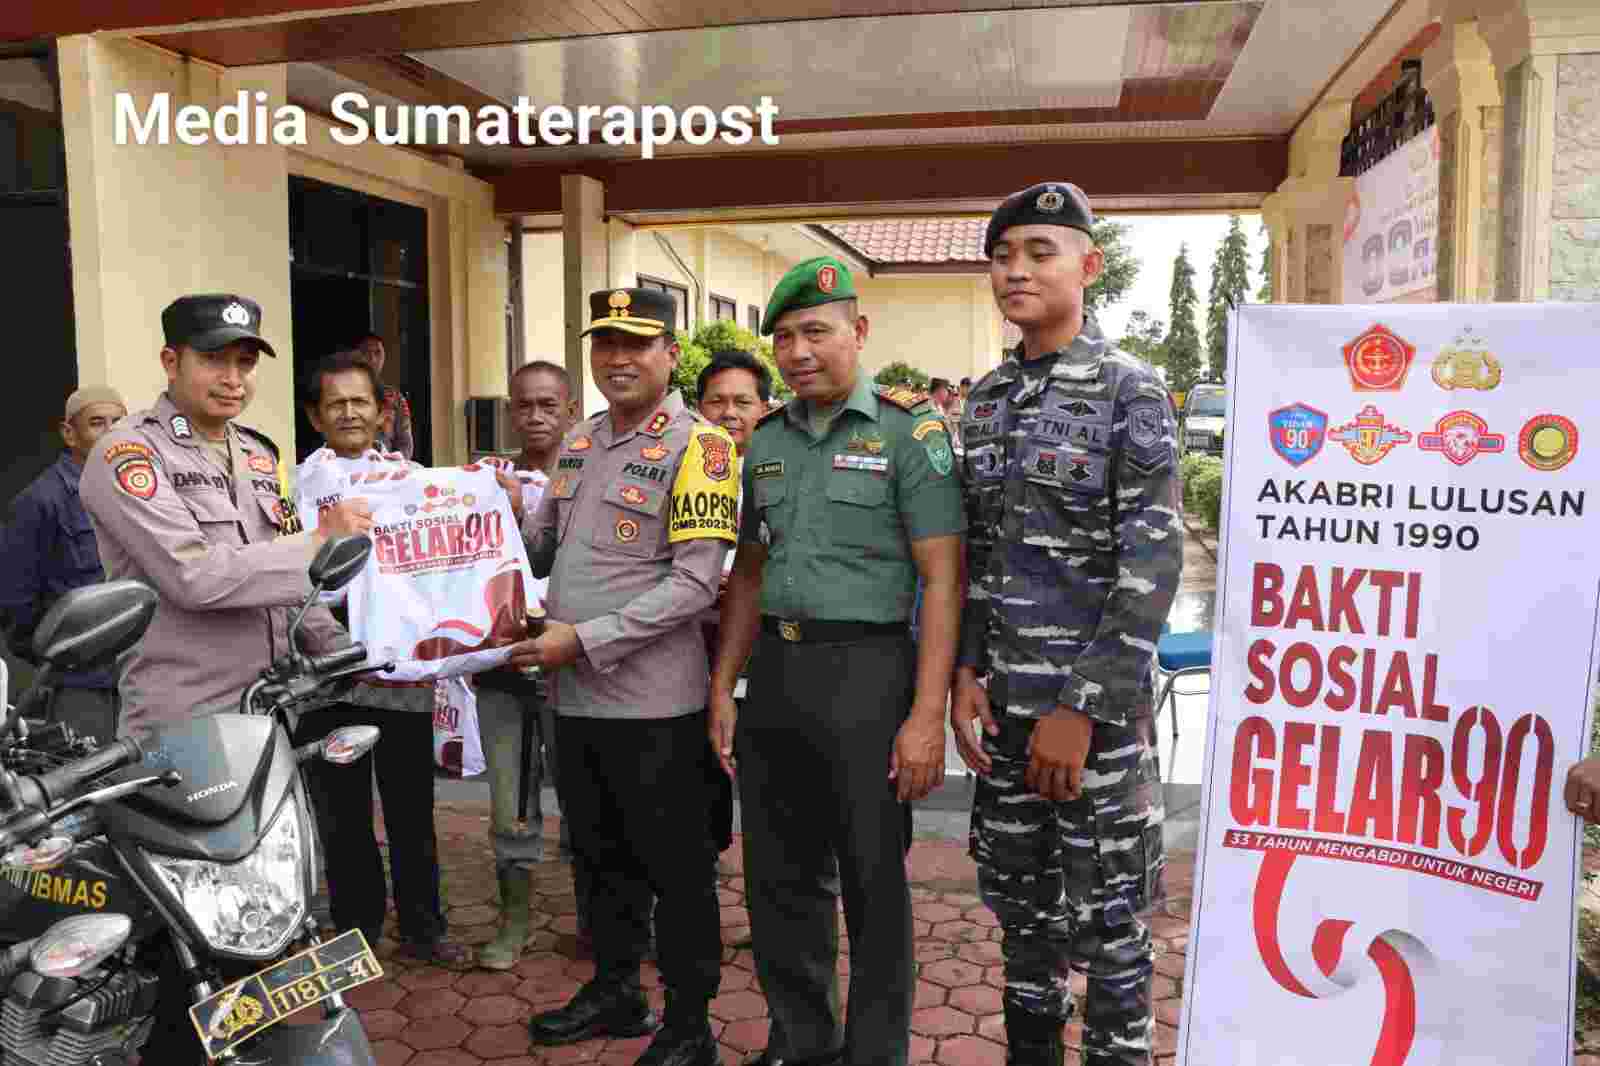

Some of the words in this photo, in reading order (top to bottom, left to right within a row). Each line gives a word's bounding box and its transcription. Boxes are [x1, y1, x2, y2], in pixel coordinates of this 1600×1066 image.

[1042, 419, 1070, 437] TNI
[1079, 429, 1103, 443] AL
[622, 463, 668, 482] POLRI
[1256, 479, 1394, 509] AKABRI
[1408, 485, 1586, 518] LULUSAN
[373, 520, 412, 537] BAKTI
[416, 514, 460, 529] SOSIAL
[1256, 514, 1380, 545] TAHUN
[1394, 522, 1480, 551] 1990
[1250, 561, 1422, 639] BAKTI
[1243, 639, 1450, 722] SOSIAL
[186, 781, 239, 802] HONDA
[1231, 832, 1250, 846] 33
[1254, 834, 1313, 852] TAHUN
[1315, 841, 1408, 865] MENGABDI
[1411, 856, 1466, 880] UNTUK
[1471, 870, 1537, 897] NEGERI
